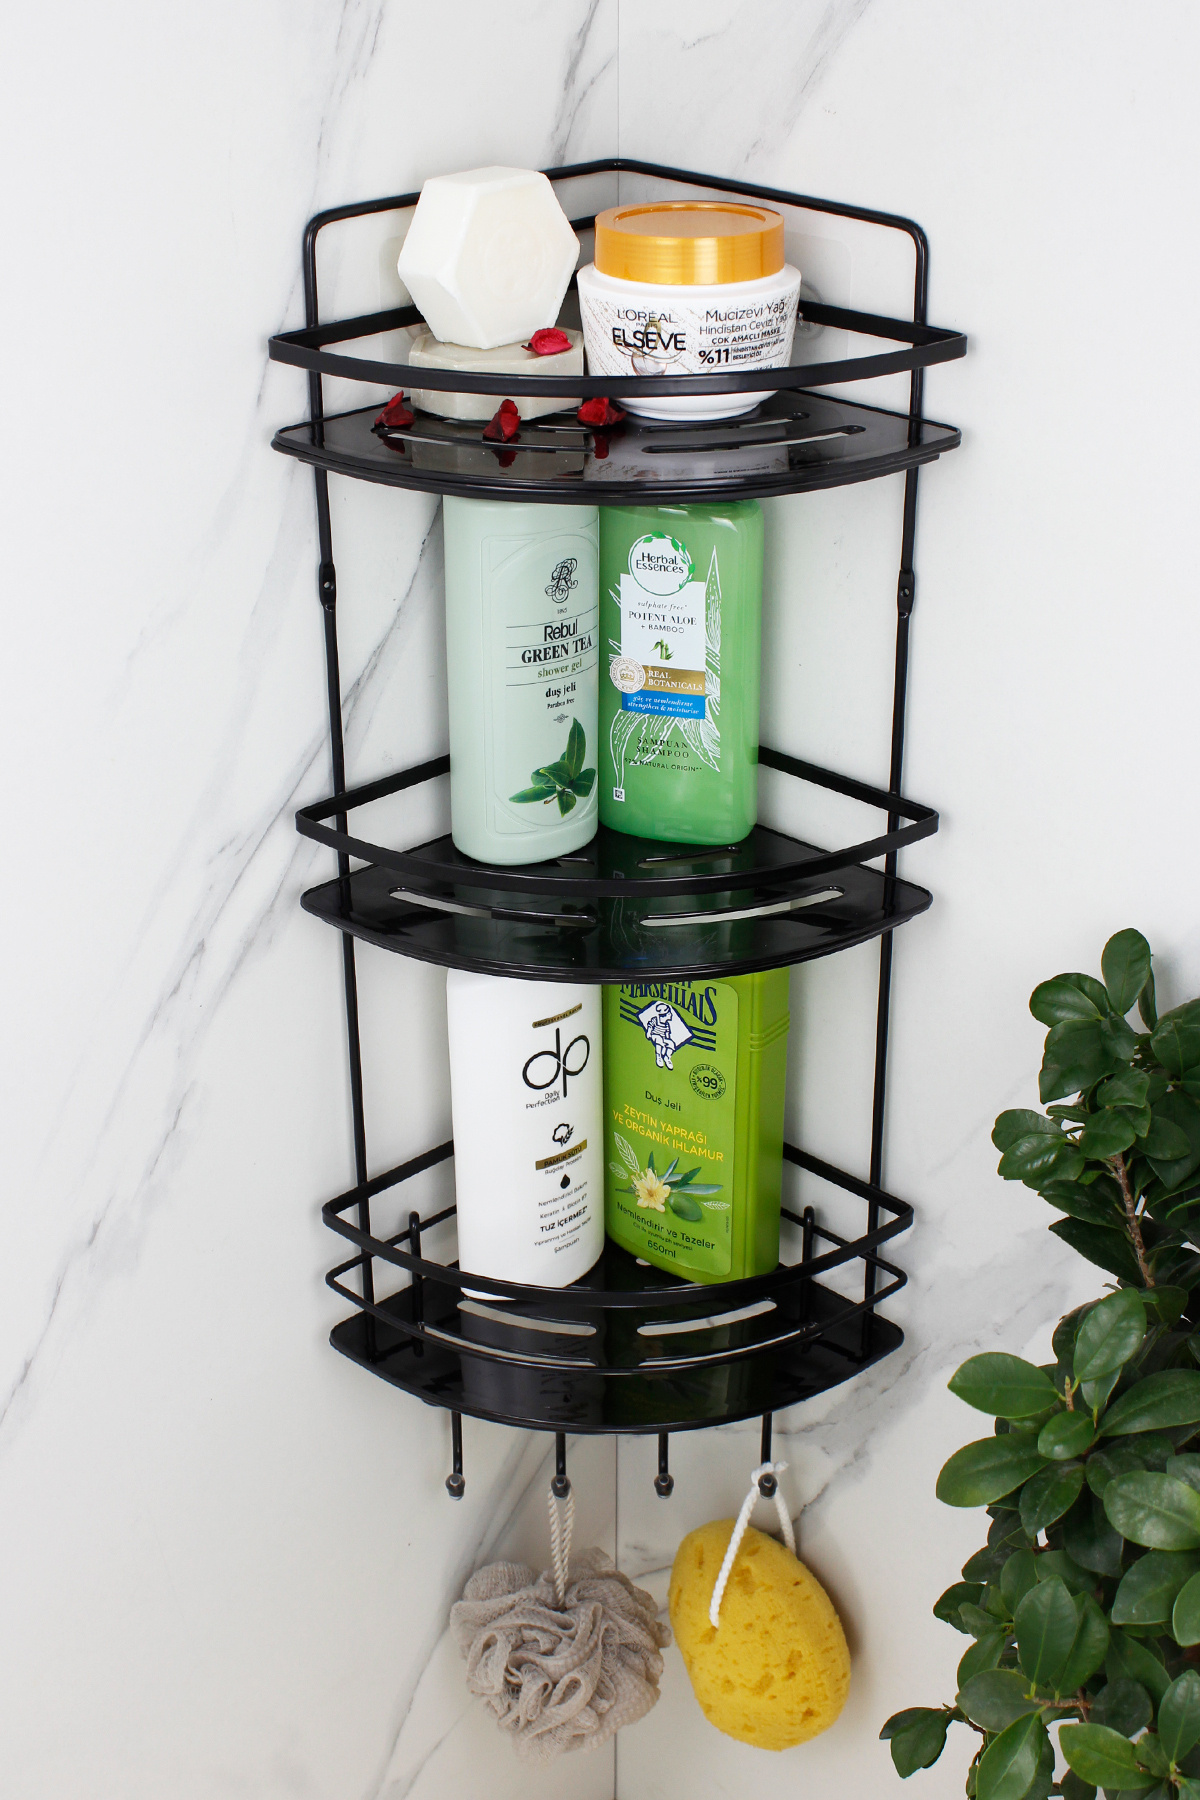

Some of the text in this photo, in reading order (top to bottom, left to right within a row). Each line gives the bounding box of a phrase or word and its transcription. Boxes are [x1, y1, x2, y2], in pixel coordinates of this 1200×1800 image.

[705, 307, 763, 323] Mucizevi
[699, 323, 747, 335] Hindistan
[711, 327, 780, 345] ÇOK AMAÇLI MASKE
[612, 327, 687, 351] ELSEVE
[698, 348, 730, 364] %11
[636, 559, 684, 574] Essences
[641, 552, 679, 566] Herbal
[628, 611, 697, 626] POTENT ALOE
[544, 618, 578, 642] Rebul
[648, 624, 685, 634] BAMBOO
[521, 634, 592, 664] GREEN TEA
[537, 658, 582, 678] shower gel
[648, 670, 671, 679] REAL
[545, 681, 577, 698] duş jeli
[648, 679, 703, 691] BOTANICALS
[636, 745, 689, 758] SHAMPOO
[639, 759, 669, 769] NATURAL
[522, 1028, 590, 1097] dp
[525, 1095, 560, 1109] Perfection
[544, 1090, 560, 1099] Daily
[645, 1091, 681, 1111] Duş Jeli
[624, 1103, 708, 1145] ZEYTİN YAPRAĞI
[613, 1109, 724, 1162] VE ORGANİK IHLAMUR
[544, 1155, 567, 1167] PAMUK
[540, 1222, 556, 1232] TUZ
[617, 1202, 716, 1250] Nemlendirir ve Tazeler
[647, 1239, 676, 1258] 650ml
